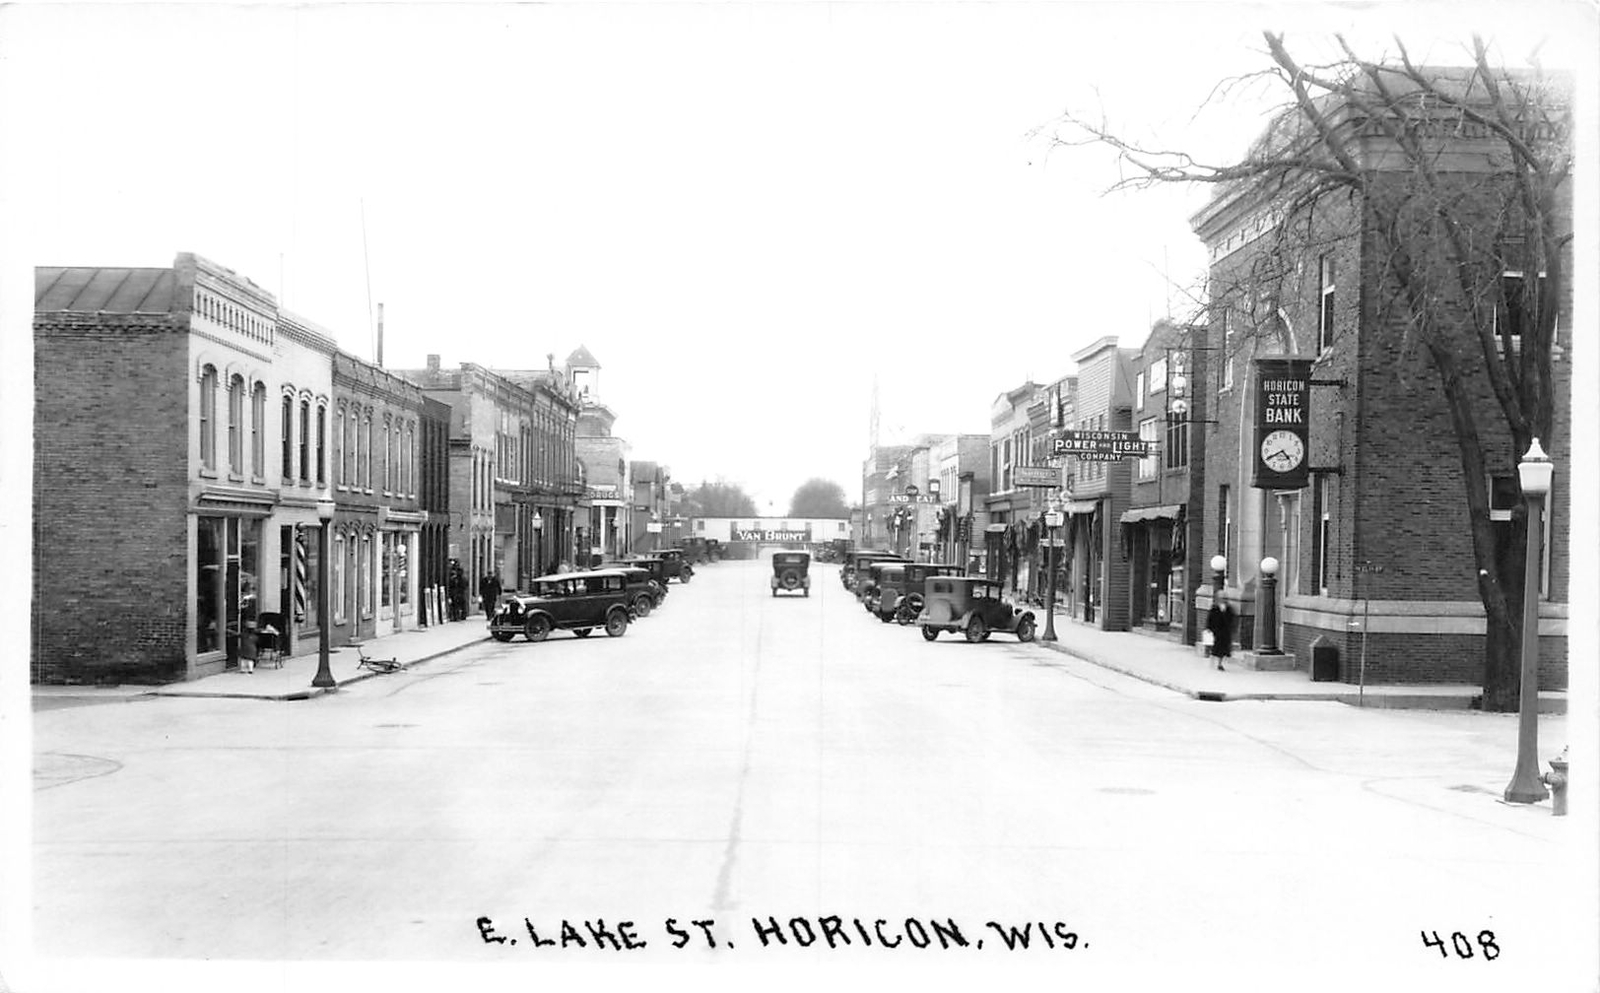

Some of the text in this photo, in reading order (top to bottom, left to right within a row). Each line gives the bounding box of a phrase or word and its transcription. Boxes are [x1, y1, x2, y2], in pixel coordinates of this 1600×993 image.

[1263, 380, 1305, 392] HORICON
[1268, 393, 1300, 406] STATE
[1265, 407, 1302, 423] BANK
[1074, 432, 1128, 440] WISCONSIN
[1055, 439, 1097, 452] POWER
[1112, 441, 1146, 454] LIGHT
[1080, 452, 1122, 461] COMPANY
[589, 490, 620, 499] DRUGS
[737, 530, 806, 541] VAN BRUNT
